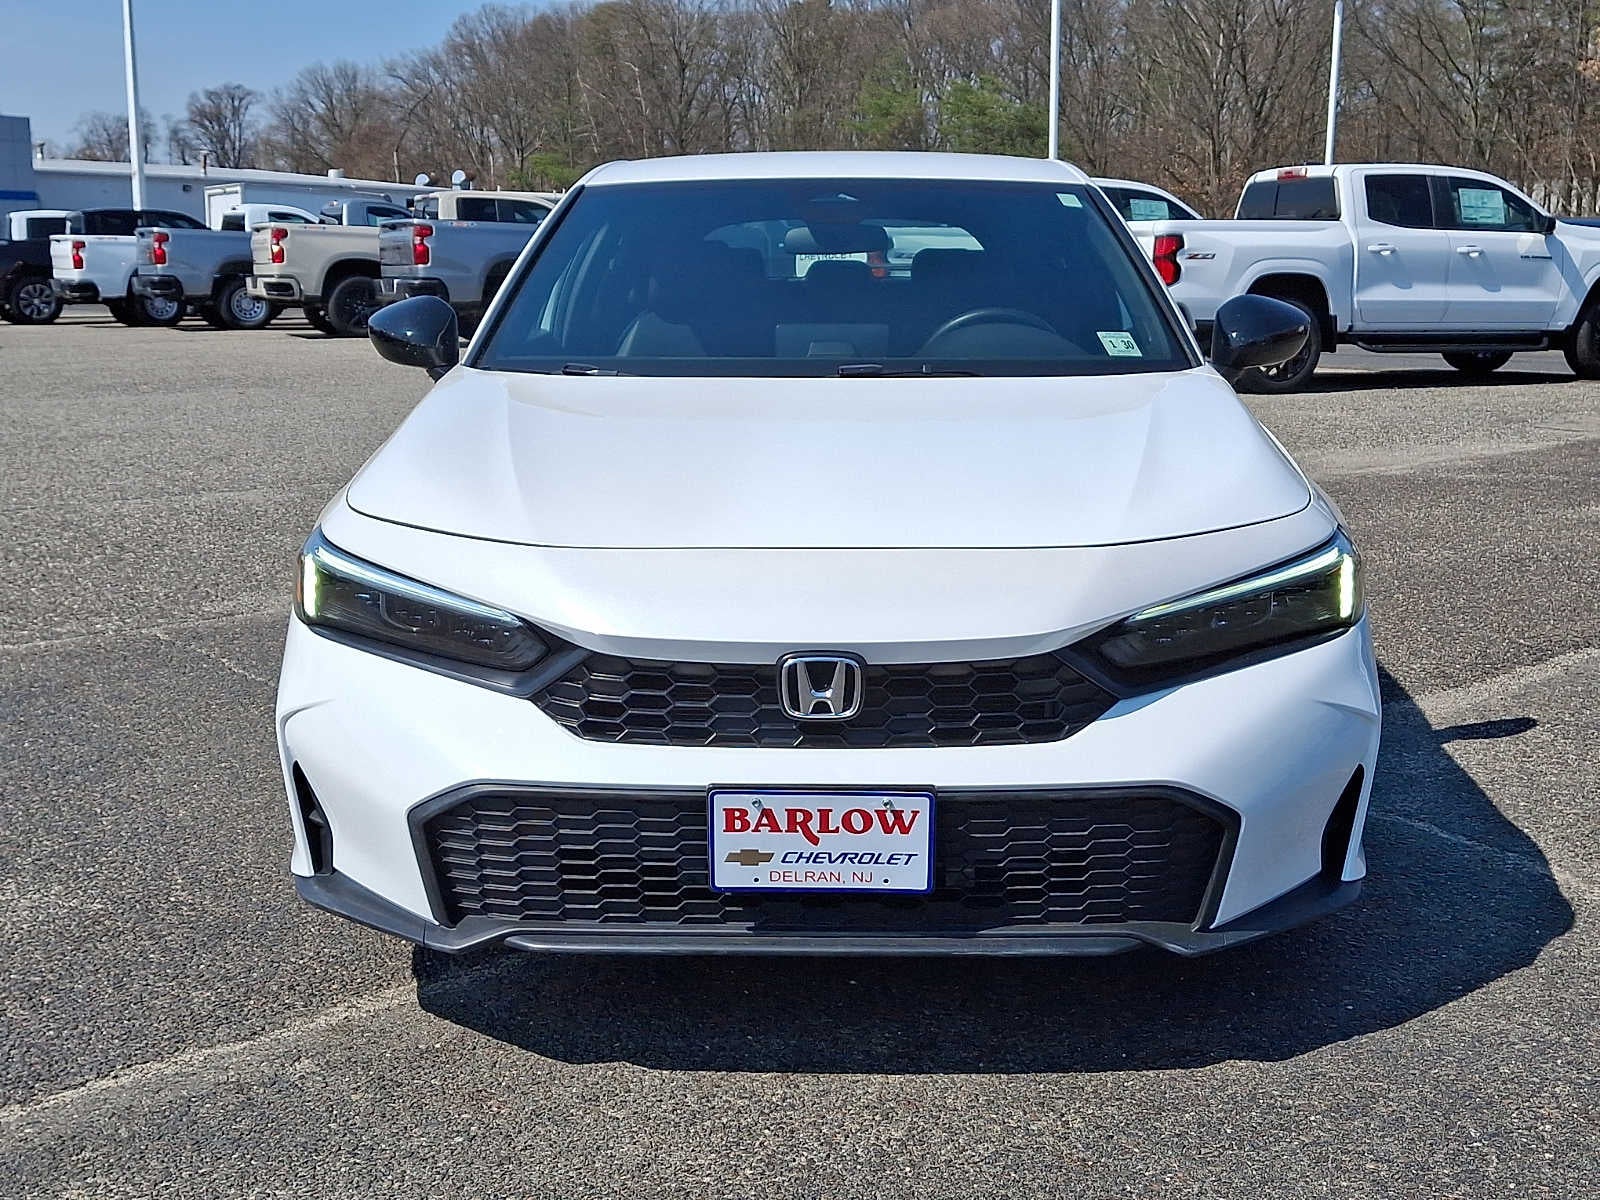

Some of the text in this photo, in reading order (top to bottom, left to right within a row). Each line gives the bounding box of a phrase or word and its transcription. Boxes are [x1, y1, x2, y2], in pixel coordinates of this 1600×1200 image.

[1109, 339, 1135, 350] 1 30
[722, 807, 920, 847] BARLOW
[780, 851, 919, 866] CHEVROLET
[769, 870, 874, 885] DELRAN, NJ
